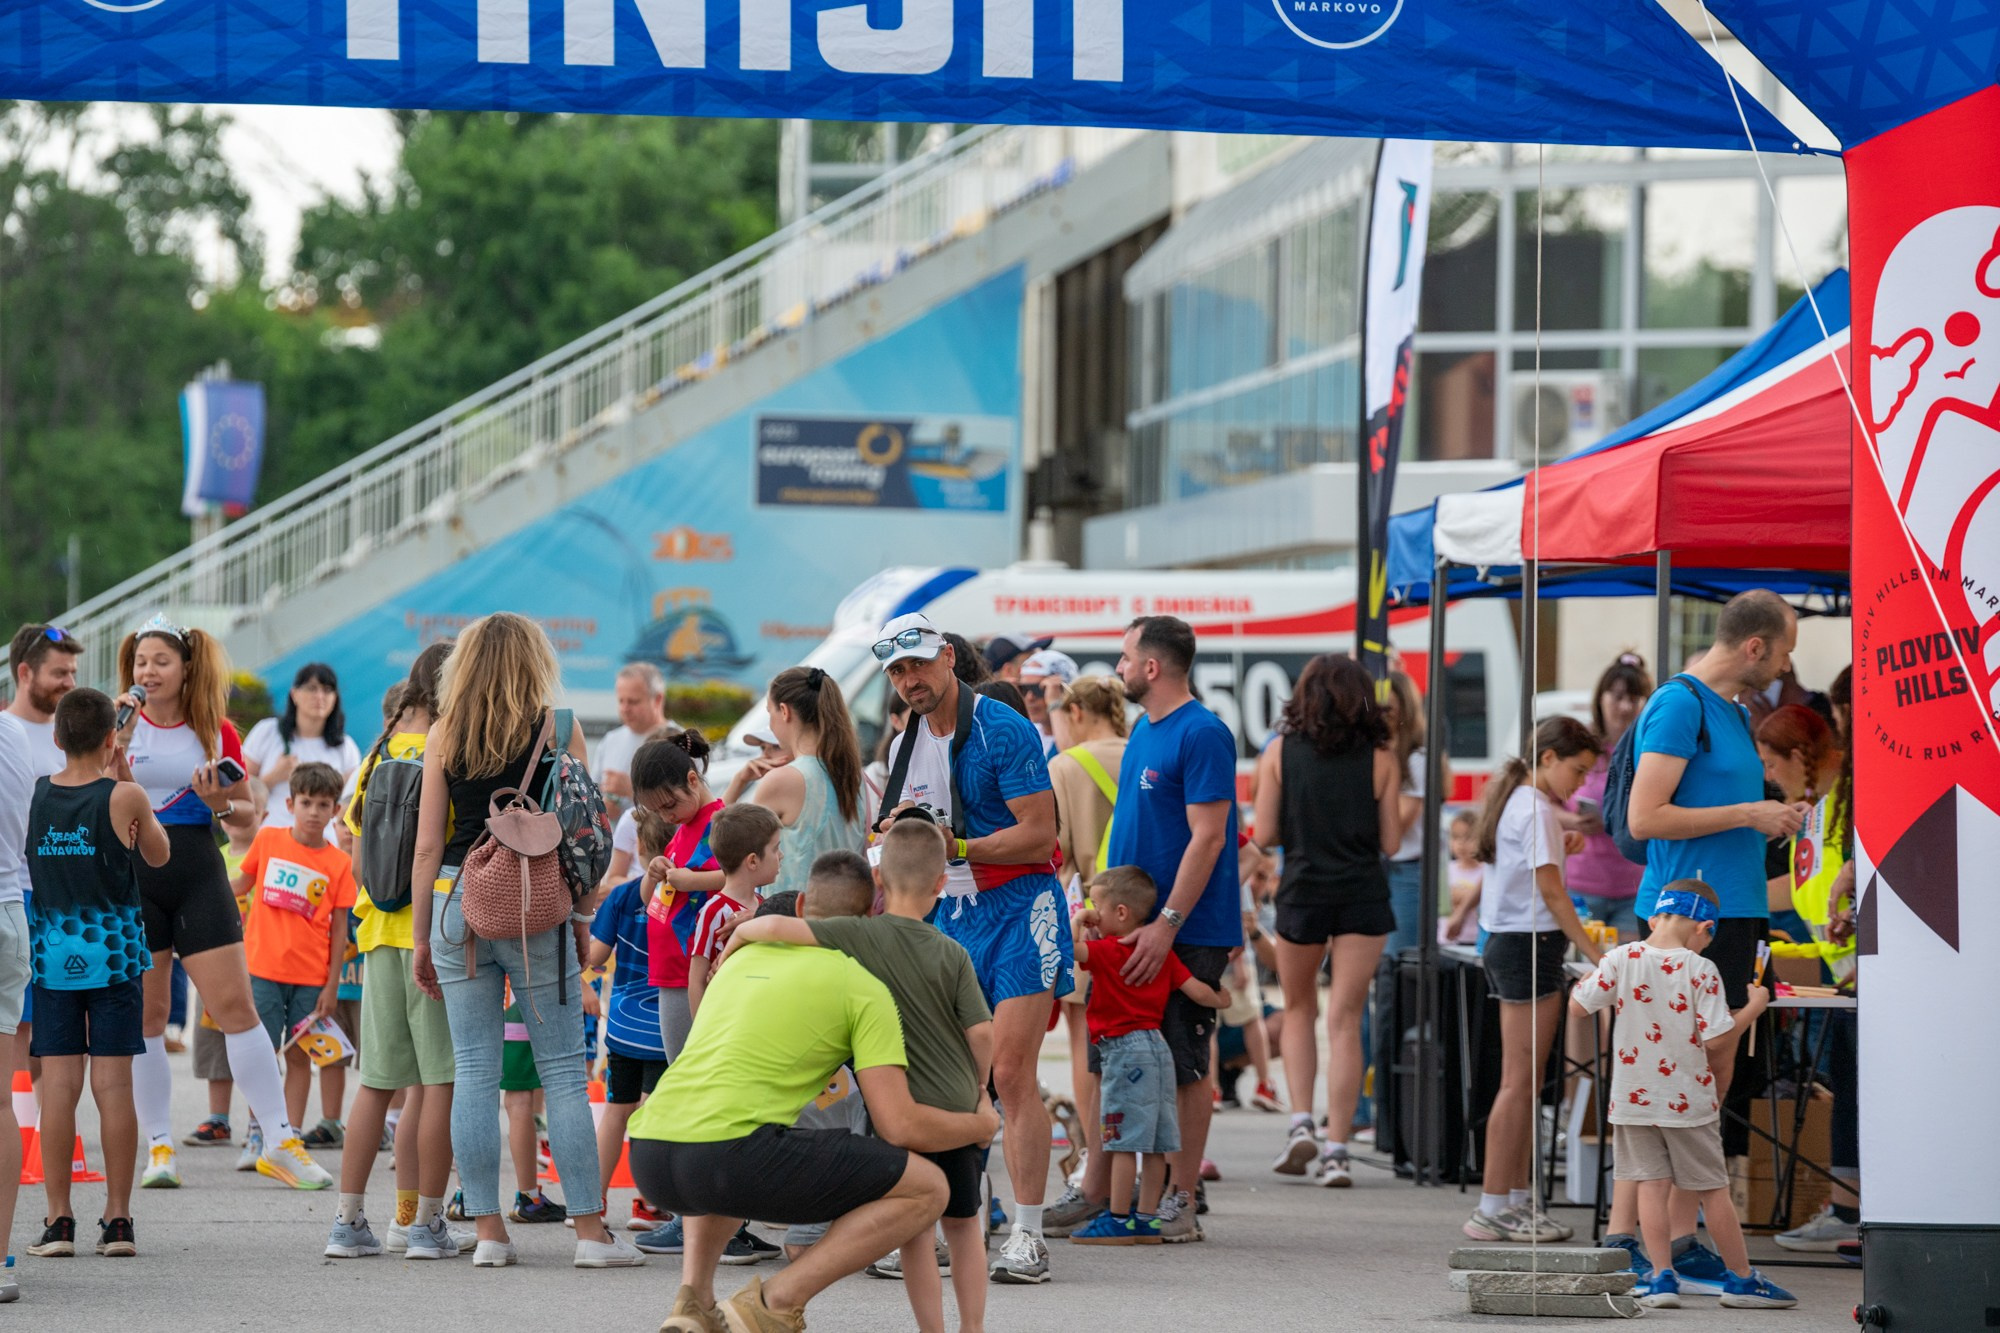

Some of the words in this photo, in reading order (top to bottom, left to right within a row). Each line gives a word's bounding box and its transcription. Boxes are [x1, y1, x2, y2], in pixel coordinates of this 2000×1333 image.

[1294, 1, 1381, 14] MARKOVO
[1861, 607, 1876, 696] PLOVDIV
[1875, 568, 1920, 604] HILLS
[1931, 567, 1951, 582] IN
[1876, 625, 1980, 677] PLOVDIV
[1895, 665, 1969, 708] HILLS
[1874, 723, 1913, 759] TRAIL
[1923, 740, 1963, 760] RUN
[37, 845, 96, 856] KLYAVKOV
[50, 832, 80, 841] TEAM
[273, 868, 299, 888] 30
